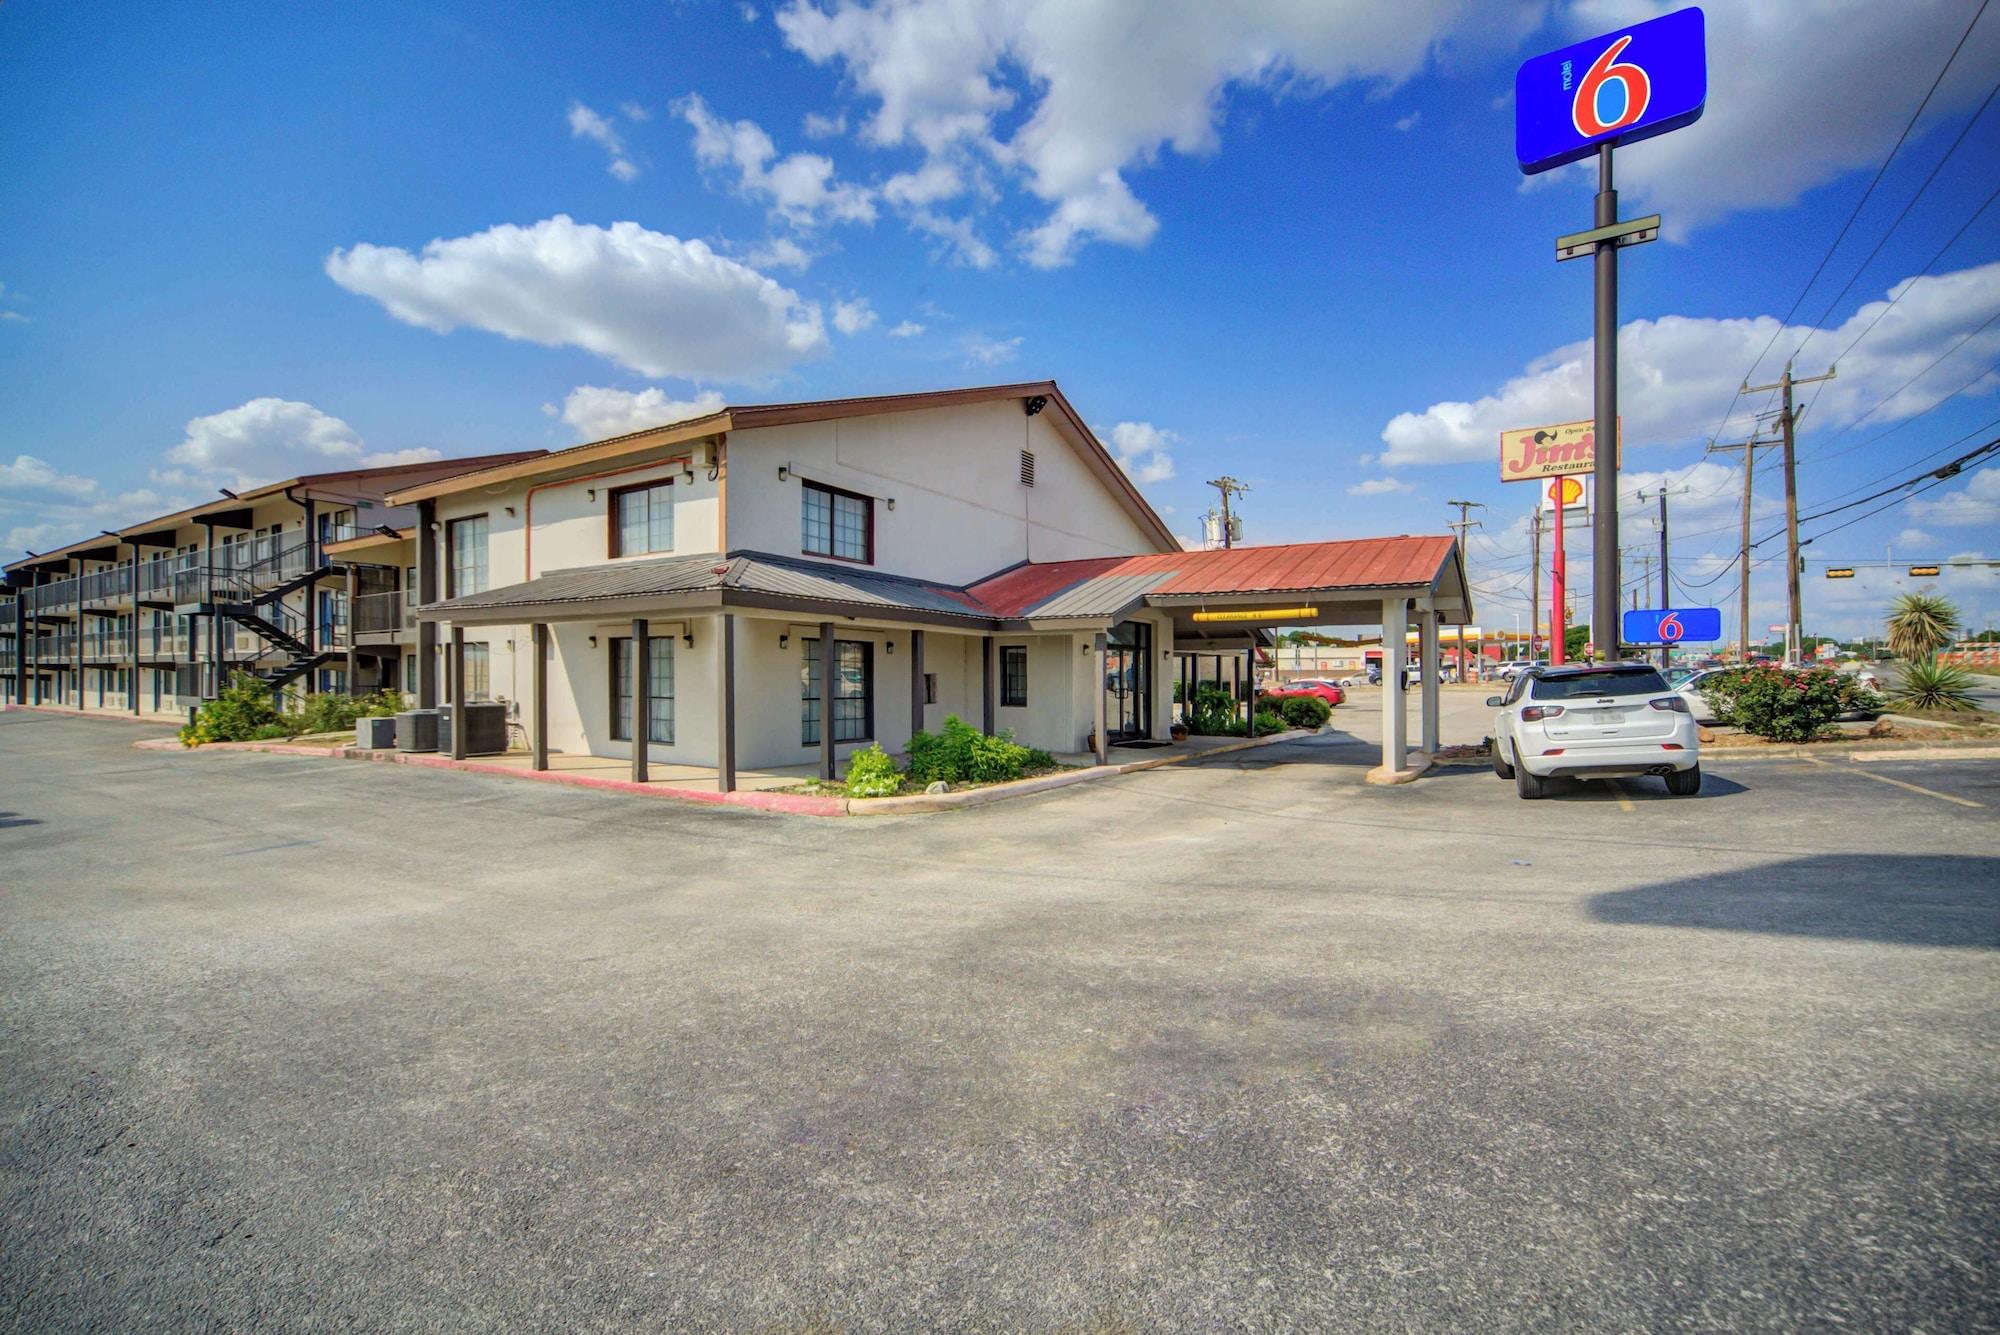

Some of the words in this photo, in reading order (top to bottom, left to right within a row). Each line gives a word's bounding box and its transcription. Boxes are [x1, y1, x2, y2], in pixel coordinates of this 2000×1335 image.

[1560, 59, 1572, 91] motel
[1572, 35, 1651, 138] 6
[1658, 611, 1684, 641] 6
